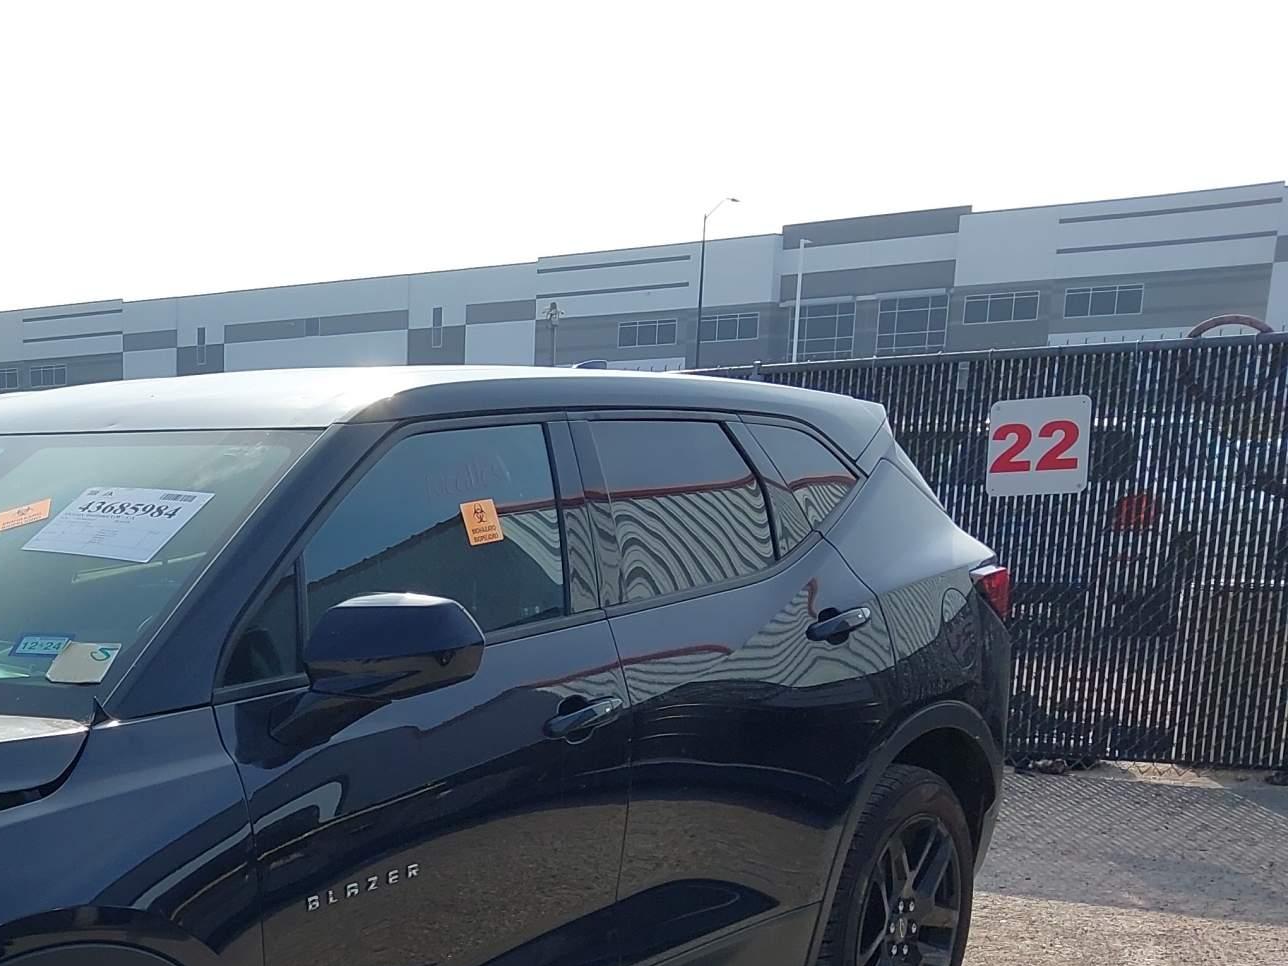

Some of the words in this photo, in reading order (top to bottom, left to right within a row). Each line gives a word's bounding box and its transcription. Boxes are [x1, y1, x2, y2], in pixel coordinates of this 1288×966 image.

[989, 420, 1080, 474] 22
[78, 499, 183, 520] 43685984
[306, 863, 420, 912] BLAZER
